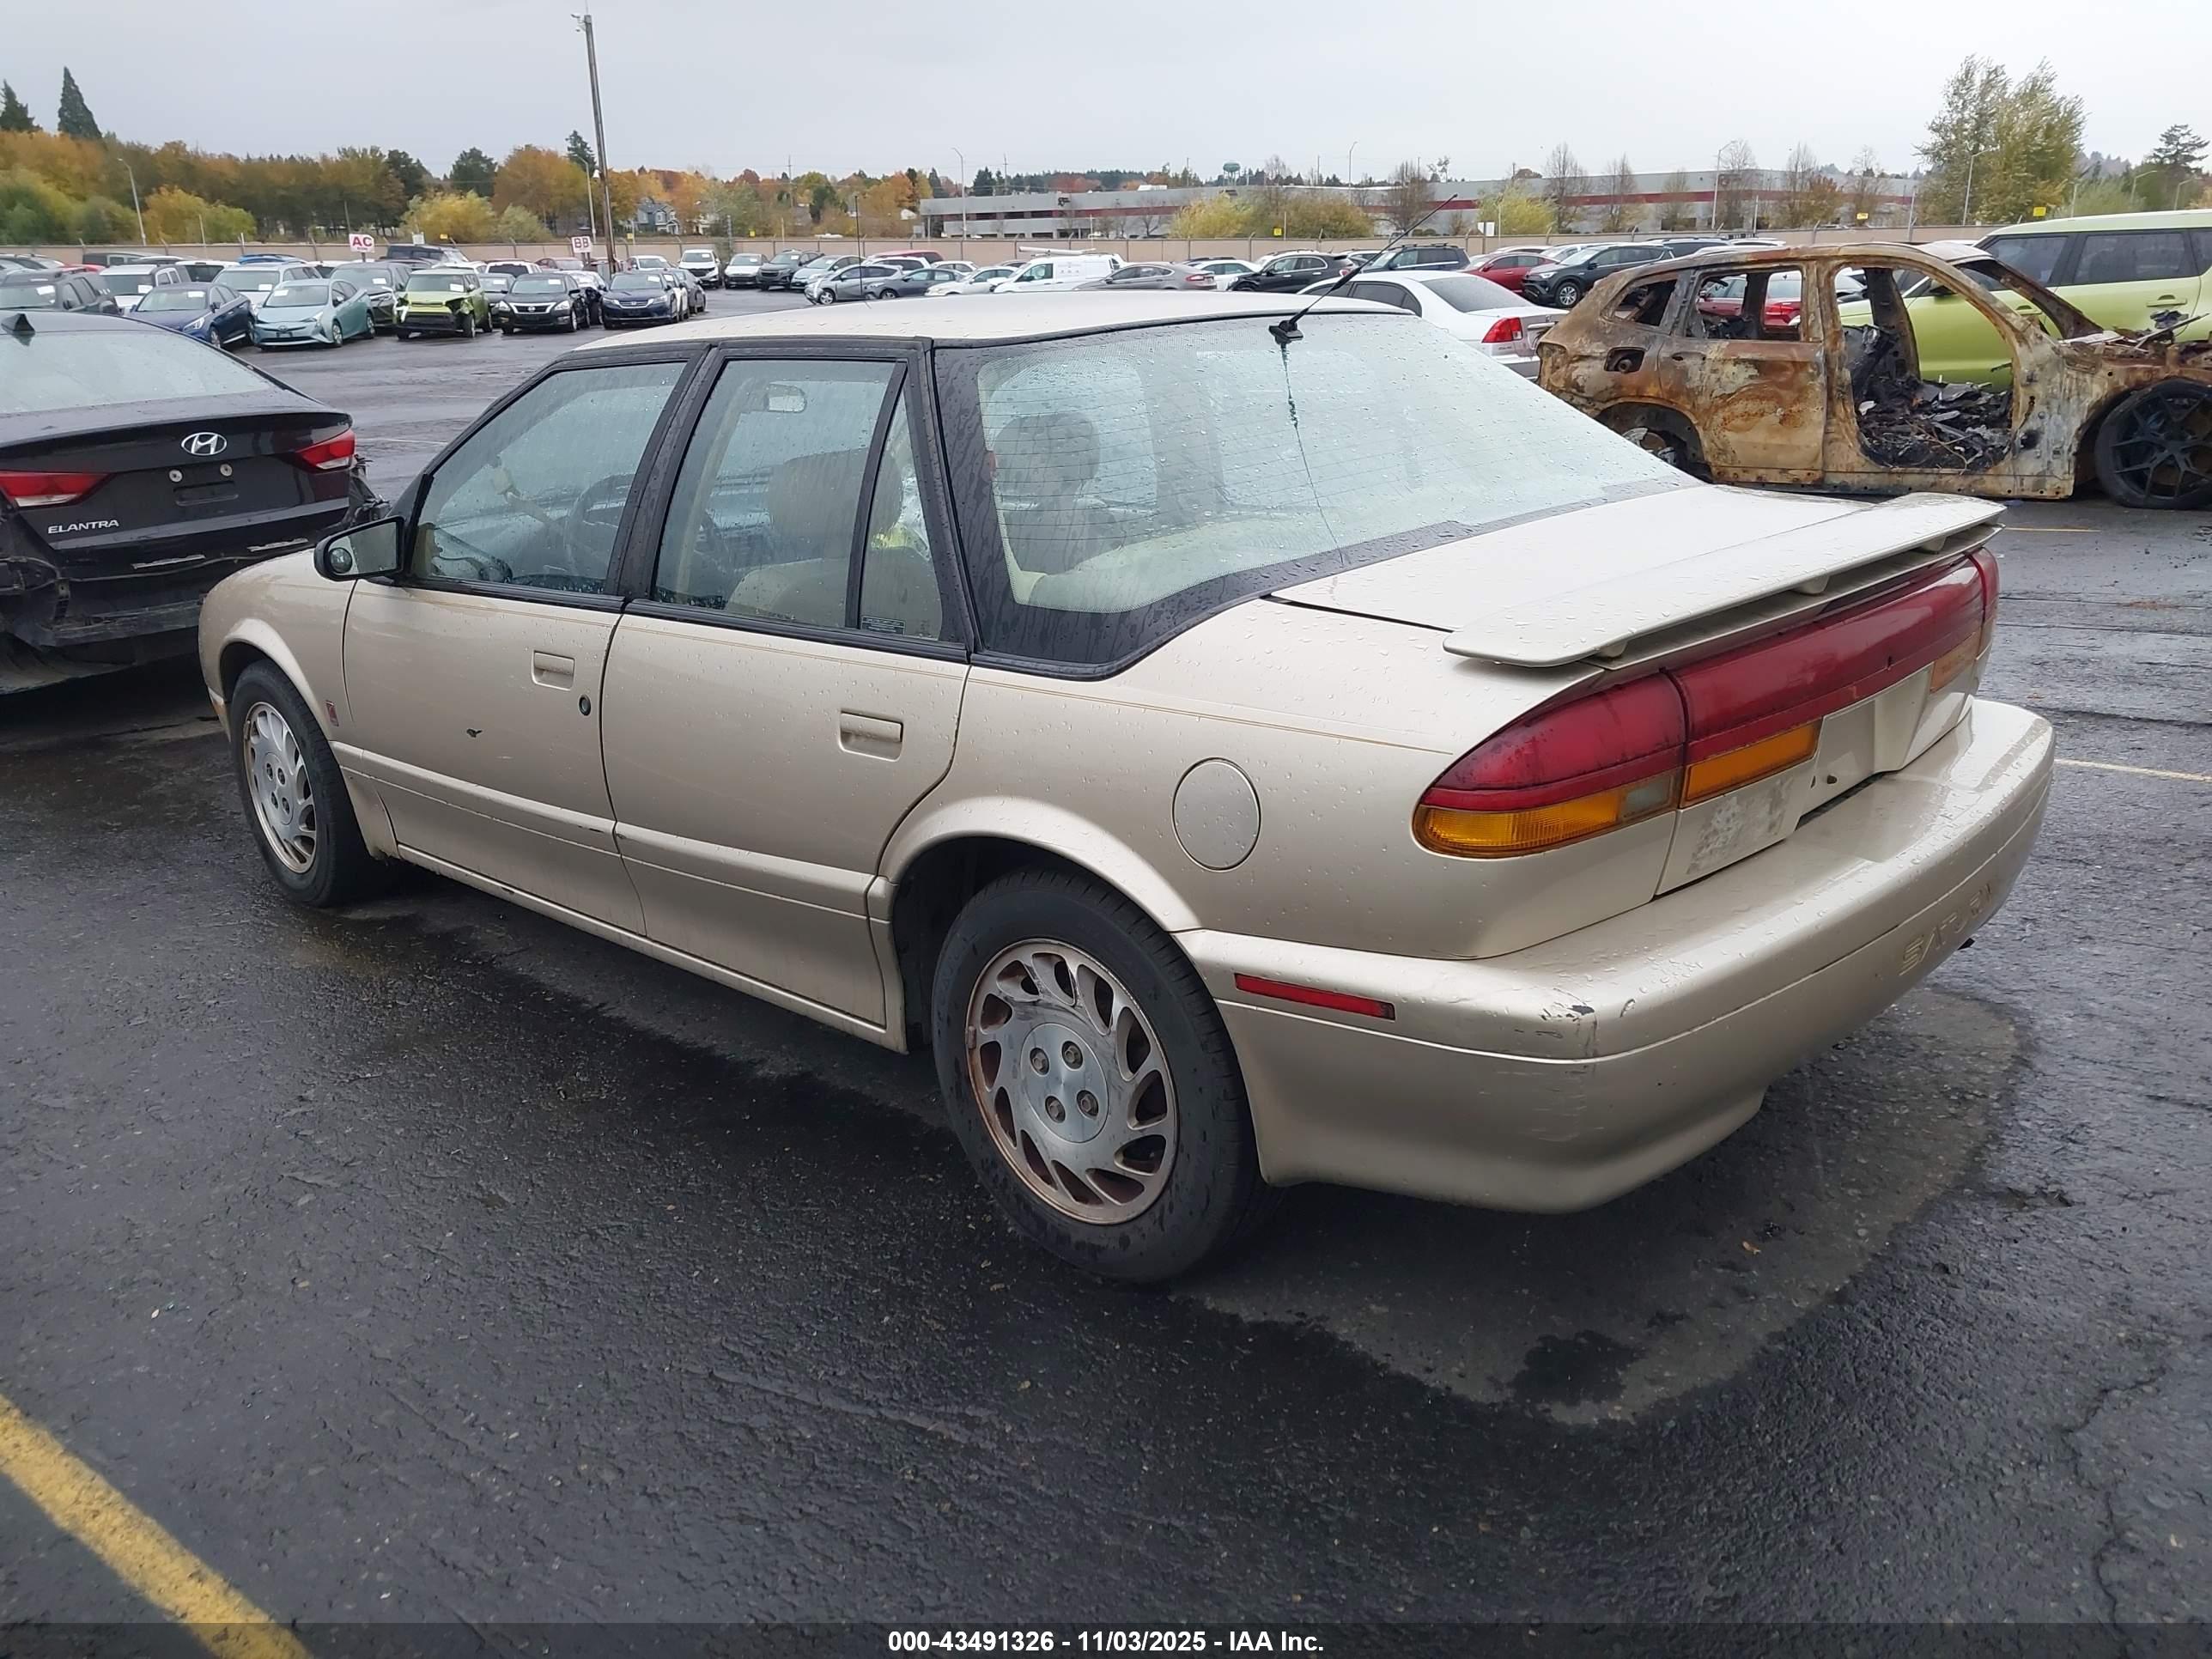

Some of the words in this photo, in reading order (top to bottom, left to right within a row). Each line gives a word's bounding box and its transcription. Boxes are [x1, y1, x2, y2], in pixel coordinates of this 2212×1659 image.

[352, 236, 374, 247] AC
[574, 237, 590, 248] BB
[48, 520, 119, 533] ELANTRA
[1898, 883, 1993, 976] SATURN
